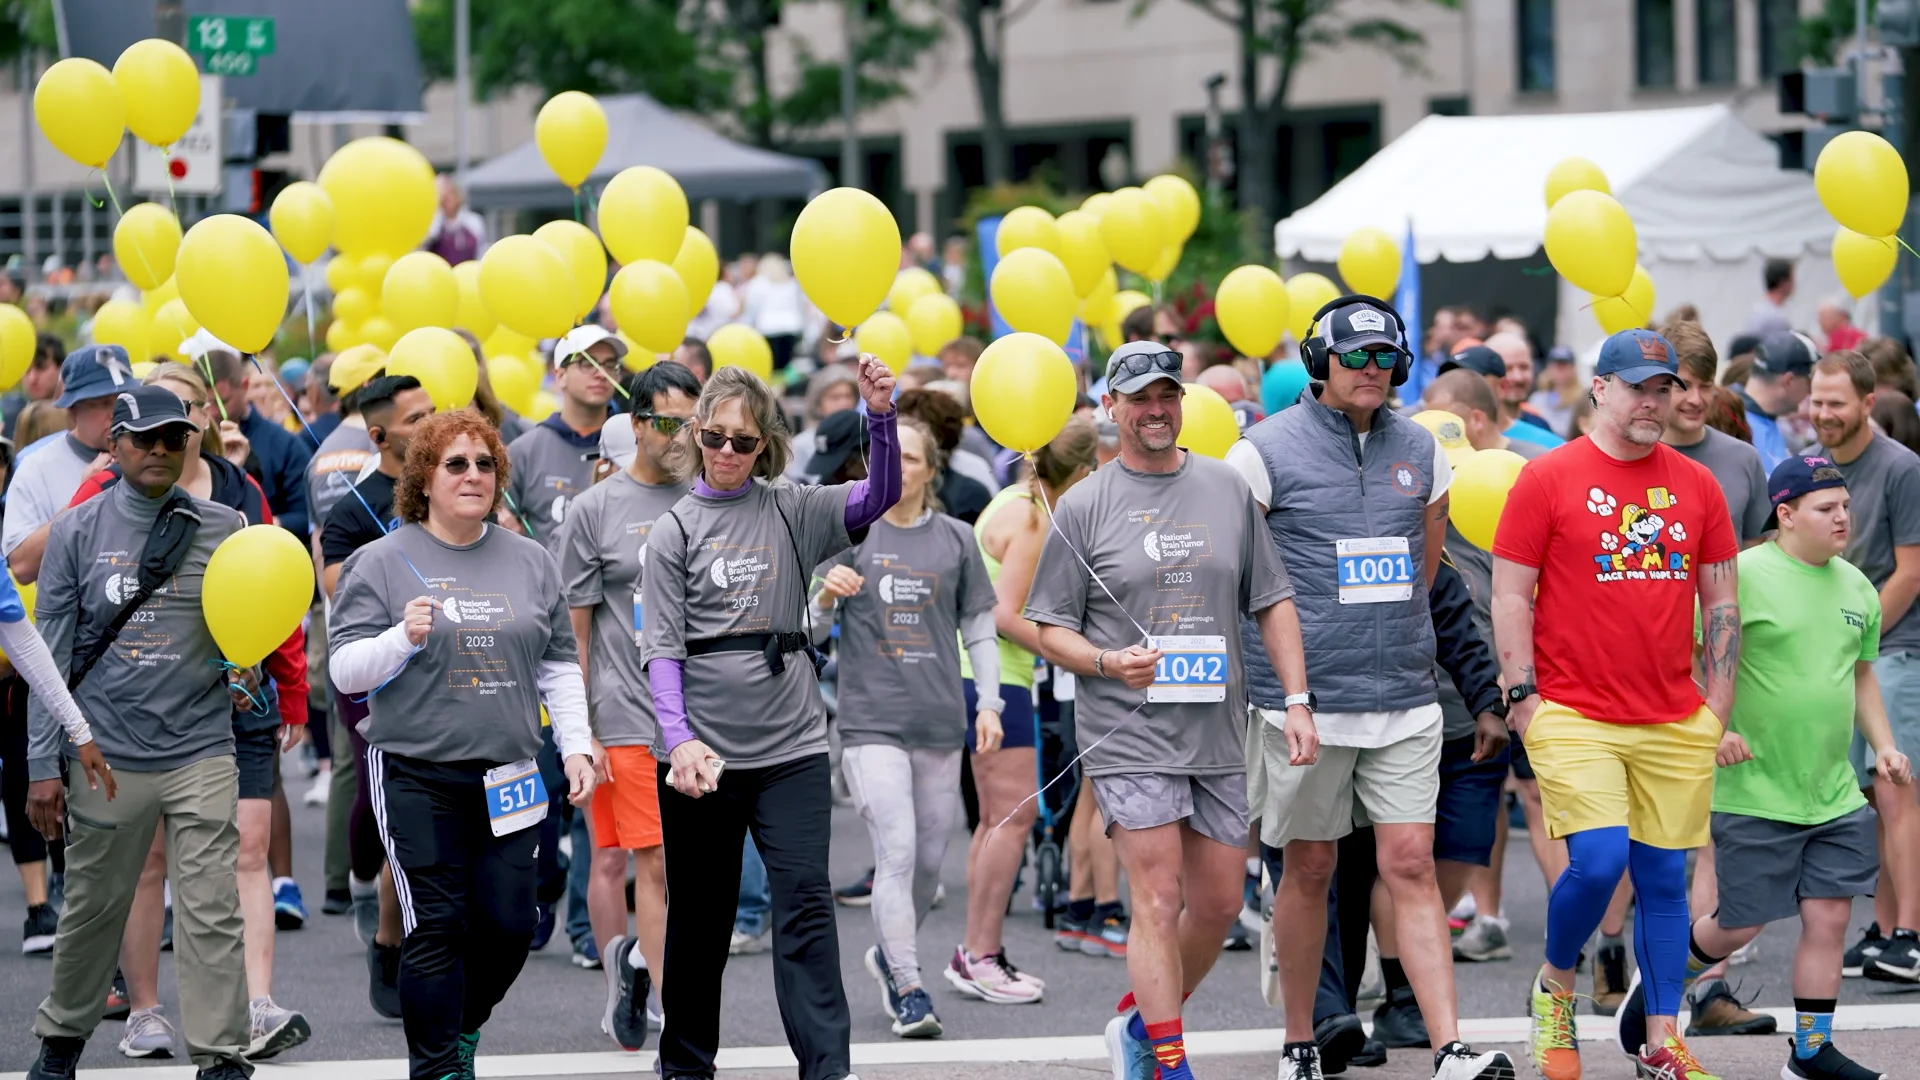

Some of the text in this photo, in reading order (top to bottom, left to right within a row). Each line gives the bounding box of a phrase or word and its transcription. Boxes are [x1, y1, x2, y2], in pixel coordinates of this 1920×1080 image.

[1128, 508, 1159, 517] Community
[1160, 532, 1191, 541] National
[1161, 540, 1204, 549] Brain Tumor
[1163, 549, 1190, 557] Society
[727, 556, 757, 568] National
[1594, 551, 1690, 572] TEAM DC
[728, 563, 769, 576] Brain Tumor
[1344, 557, 1410, 583] 1001
[730, 574, 756, 584] Society
[1164, 572, 1193, 584] 2023
[1596, 571, 1624, 582] RACE
[1626, 570, 1646, 580] FOR
[1649, 570, 1671, 580] HOPE
[731, 595, 759, 609] 2023
[461, 606, 479, 614] Brain
[127, 611, 155, 622] 023
[462, 614, 490, 622] Society
[892, 612, 919, 624] 2023
[1178, 615, 1214, 623] Breakthroughs
[466, 636, 495, 647] 2023
[138, 653, 181, 661] Breakthroughs
[1154, 656, 1222, 682] 1042
[479, 680, 517, 688] Breakthroughs
[498, 778, 536, 812] 517
